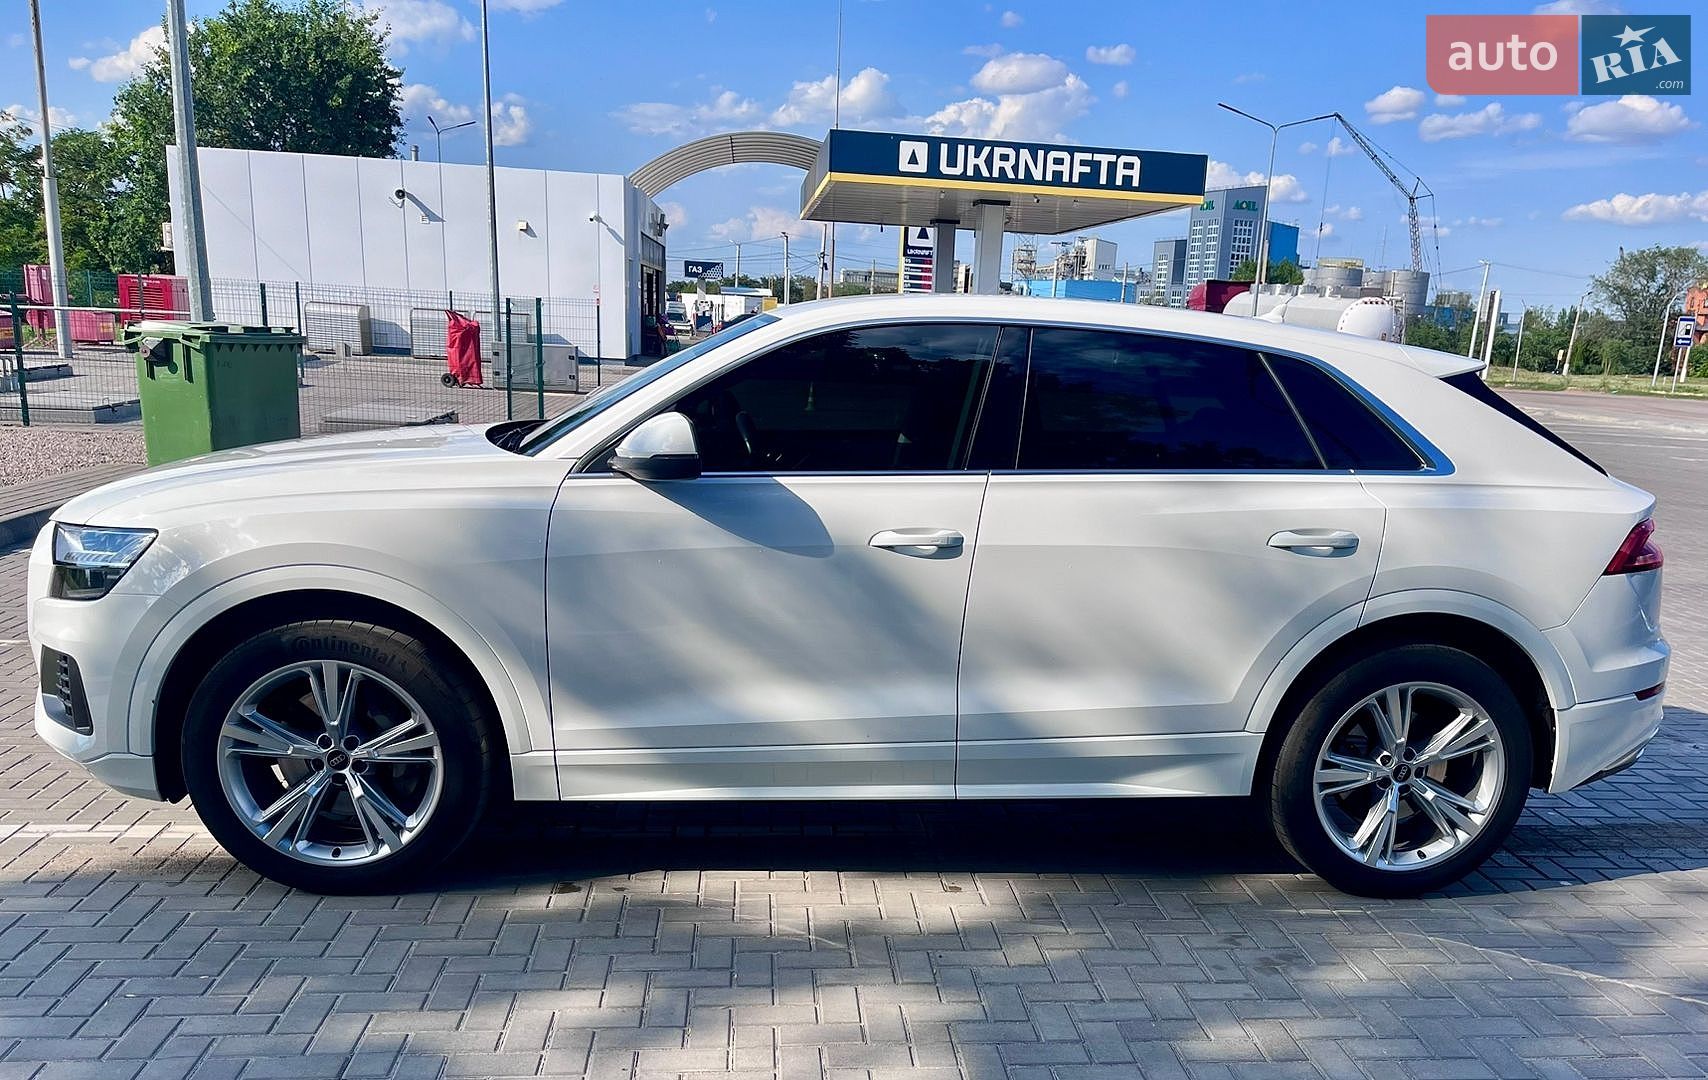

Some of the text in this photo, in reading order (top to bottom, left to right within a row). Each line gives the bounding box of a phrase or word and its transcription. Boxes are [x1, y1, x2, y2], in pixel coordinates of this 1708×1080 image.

[939, 143, 1141, 187] UKRNAFTA
[689, 265, 702, 273] ГАЗ
[293, 635, 396, 666] Continental
